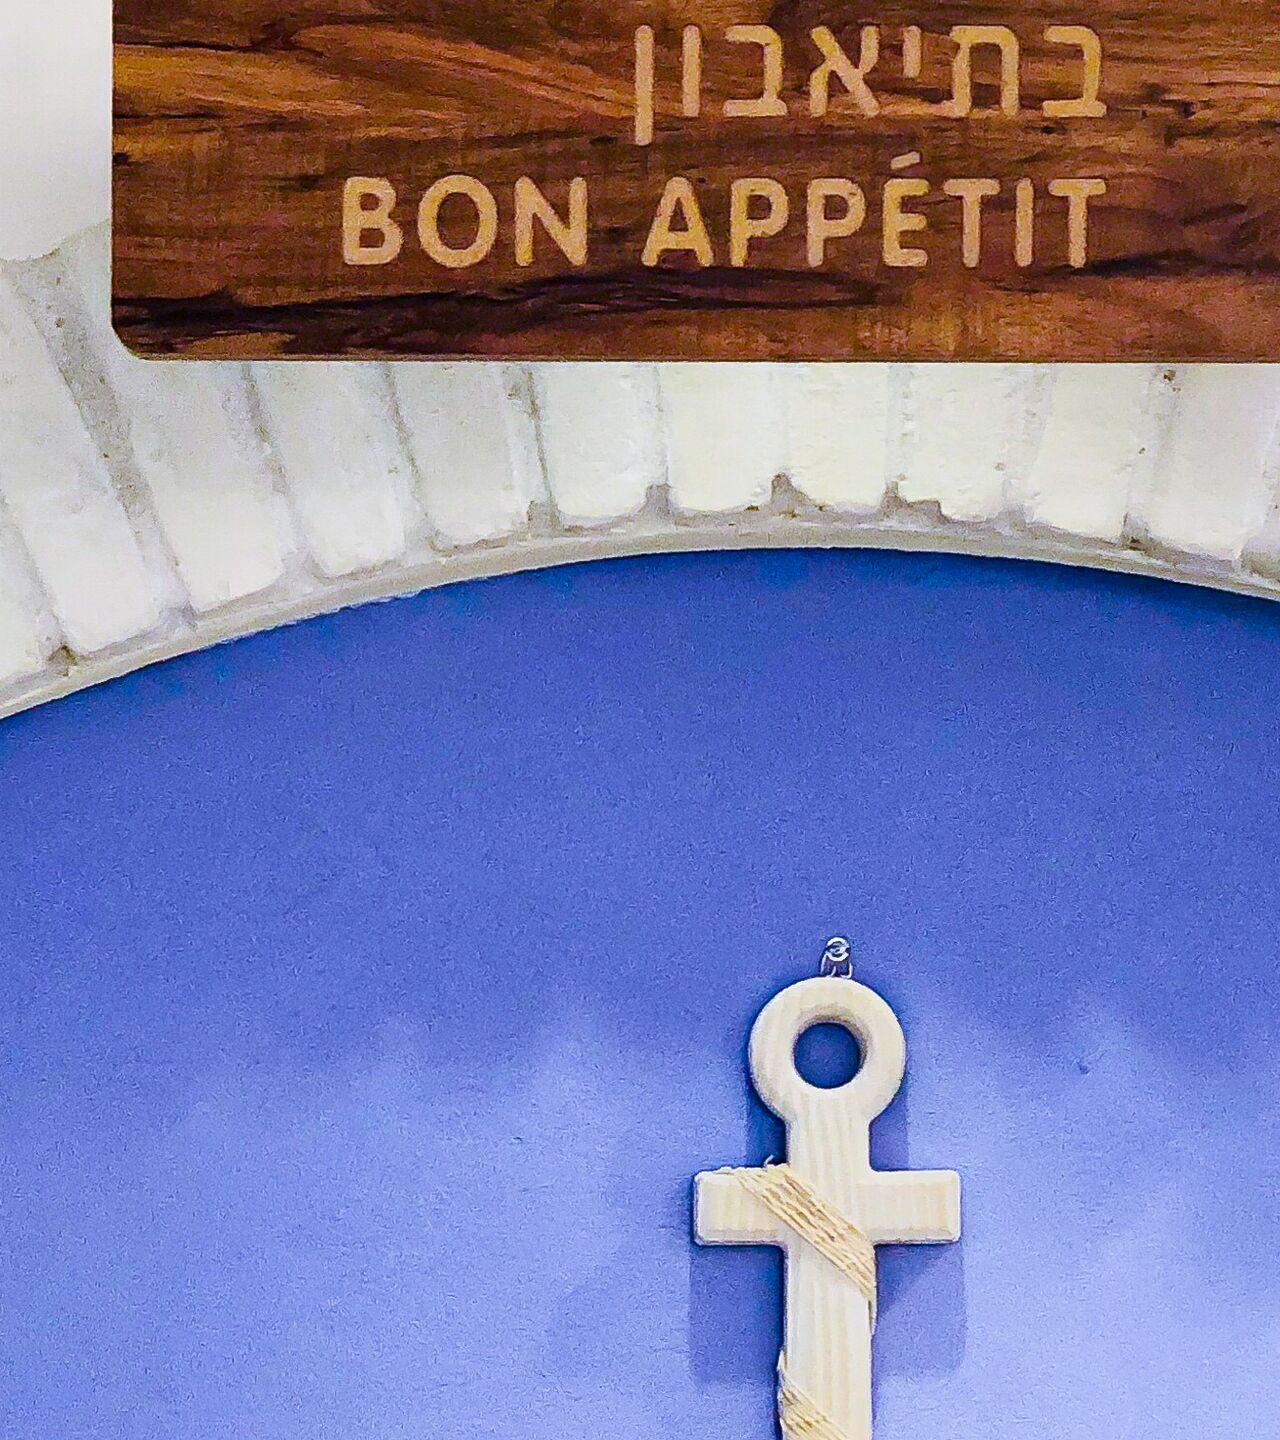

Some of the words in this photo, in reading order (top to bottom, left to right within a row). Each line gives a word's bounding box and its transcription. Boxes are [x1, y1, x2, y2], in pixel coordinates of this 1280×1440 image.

[634, 24, 1108, 146] בתיאבון
[342, 174, 589, 268] BON
[641, 151, 1107, 268] APPÉTIT
